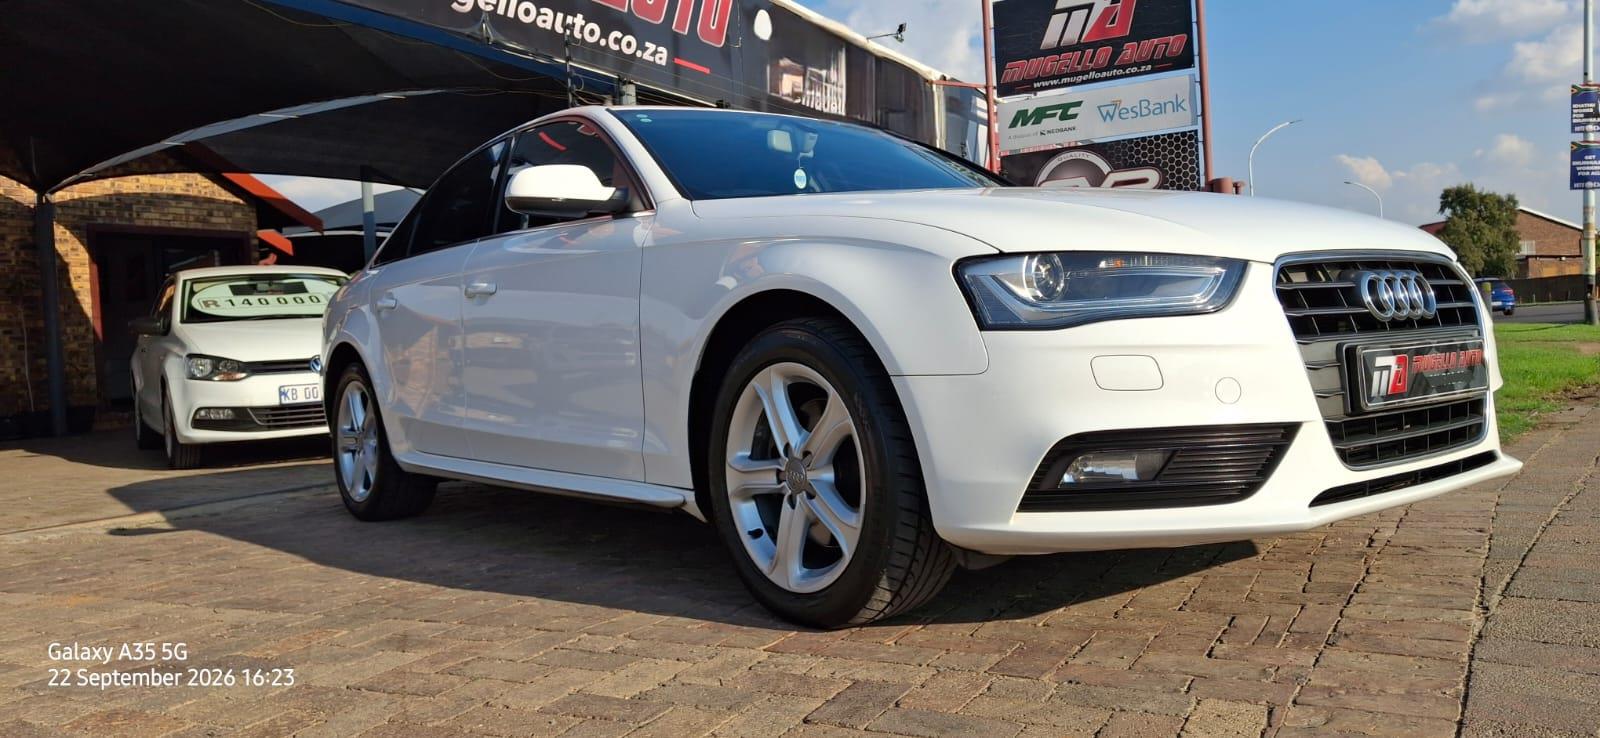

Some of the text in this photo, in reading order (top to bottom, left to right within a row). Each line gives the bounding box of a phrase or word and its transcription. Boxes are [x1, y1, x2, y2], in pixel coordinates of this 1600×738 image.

[1000, 34, 1187, 84] MUGELLO AUTO
[1033, 64, 1152, 88] www.mugelloauto.co.za
[1008, 100, 1084, 129] MFC
[1097, 93, 1188, 122] WesBank
[202, 299, 221, 308] R
